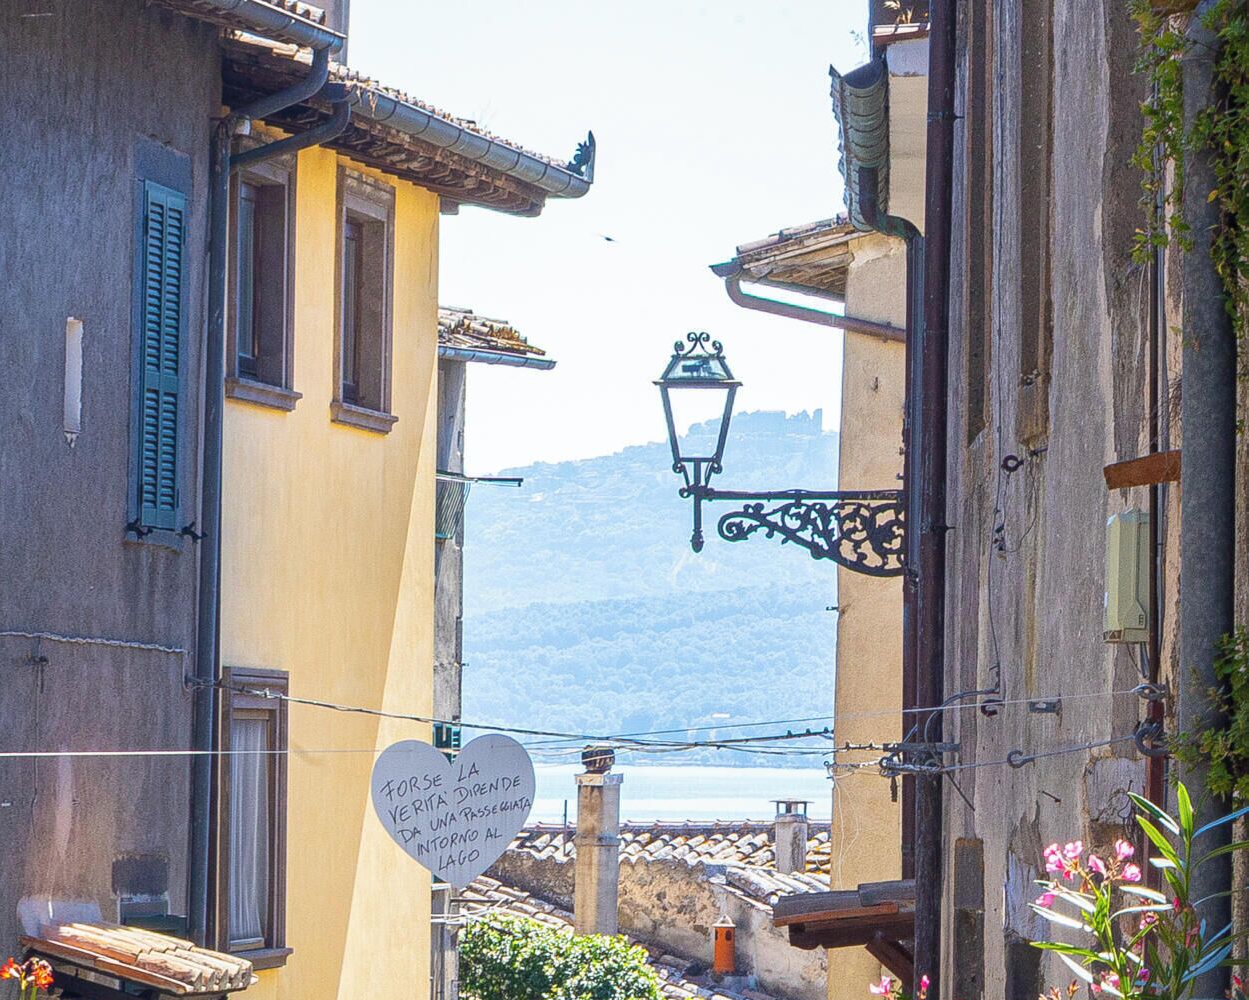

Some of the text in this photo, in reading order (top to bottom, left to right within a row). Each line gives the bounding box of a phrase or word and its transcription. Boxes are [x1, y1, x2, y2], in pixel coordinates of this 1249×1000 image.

[380, 762, 479, 801] FORSE LA
[454, 775, 521, 804] DIPENDE
[397, 797, 530, 843] DA UNA PASSEGGIATA
[417, 828, 503, 856] INTORNO AL
[439, 849, 479, 871] LAGO
